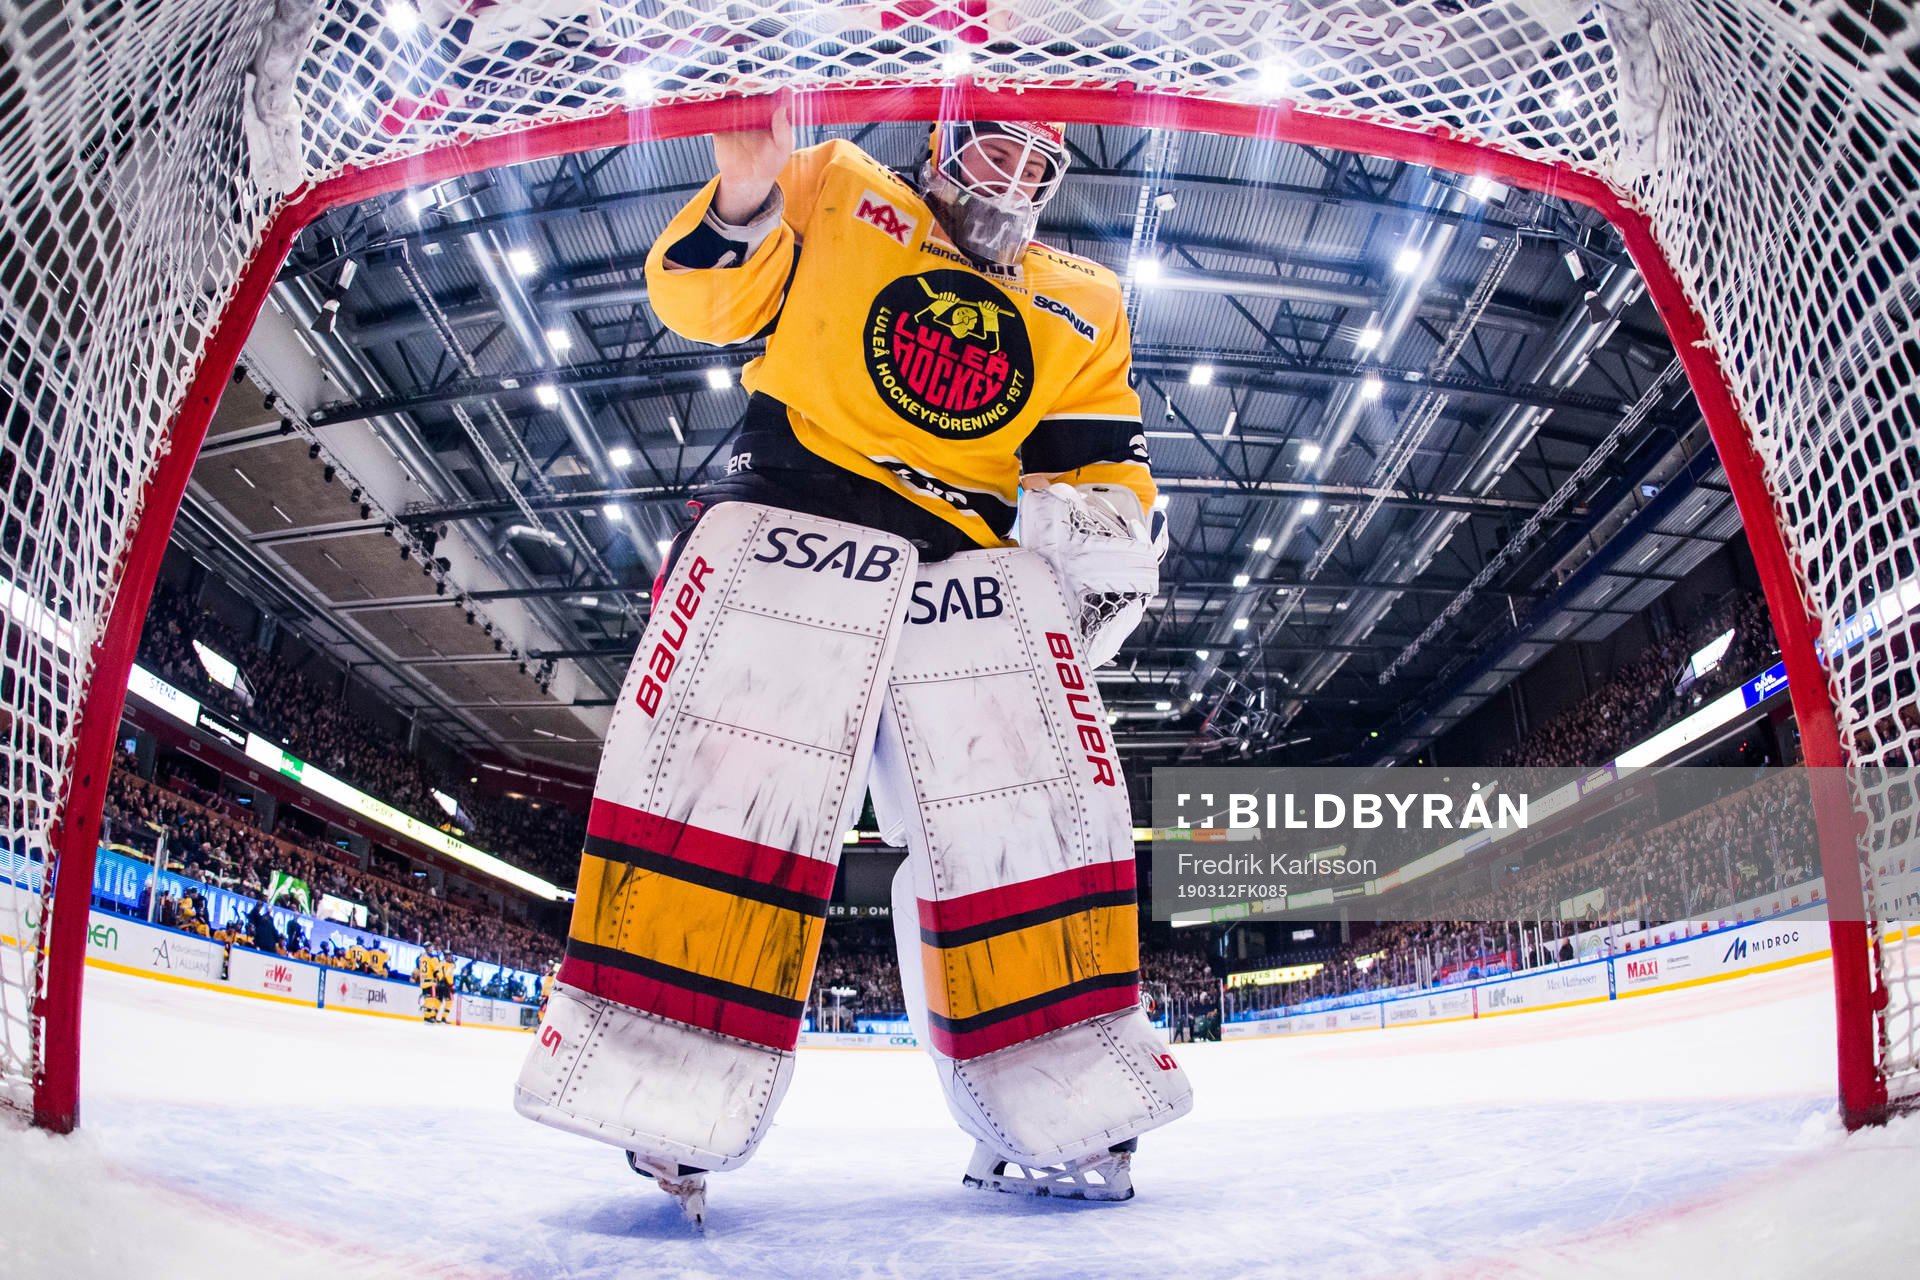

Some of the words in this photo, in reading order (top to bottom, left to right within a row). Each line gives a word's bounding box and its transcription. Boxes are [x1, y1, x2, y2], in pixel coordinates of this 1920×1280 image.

[856, 198, 912, 244] MAX
[872, 306, 893, 358] LULEÅ
[1034, 295, 1095, 341] SCANIA
[894, 311, 1010, 383] LULEÅ
[876, 362, 1009, 431] HOCKEYFÖRENING
[893, 333, 1003, 412] HOCKEY
[1006, 369, 1025, 403] 1977
[753, 527, 900, 582] SSAB
[903, 576, 1004, 625] SAB
[1752, 931, 1799, 952] MIDROC
[1627, 961, 1659, 979] MAXI
